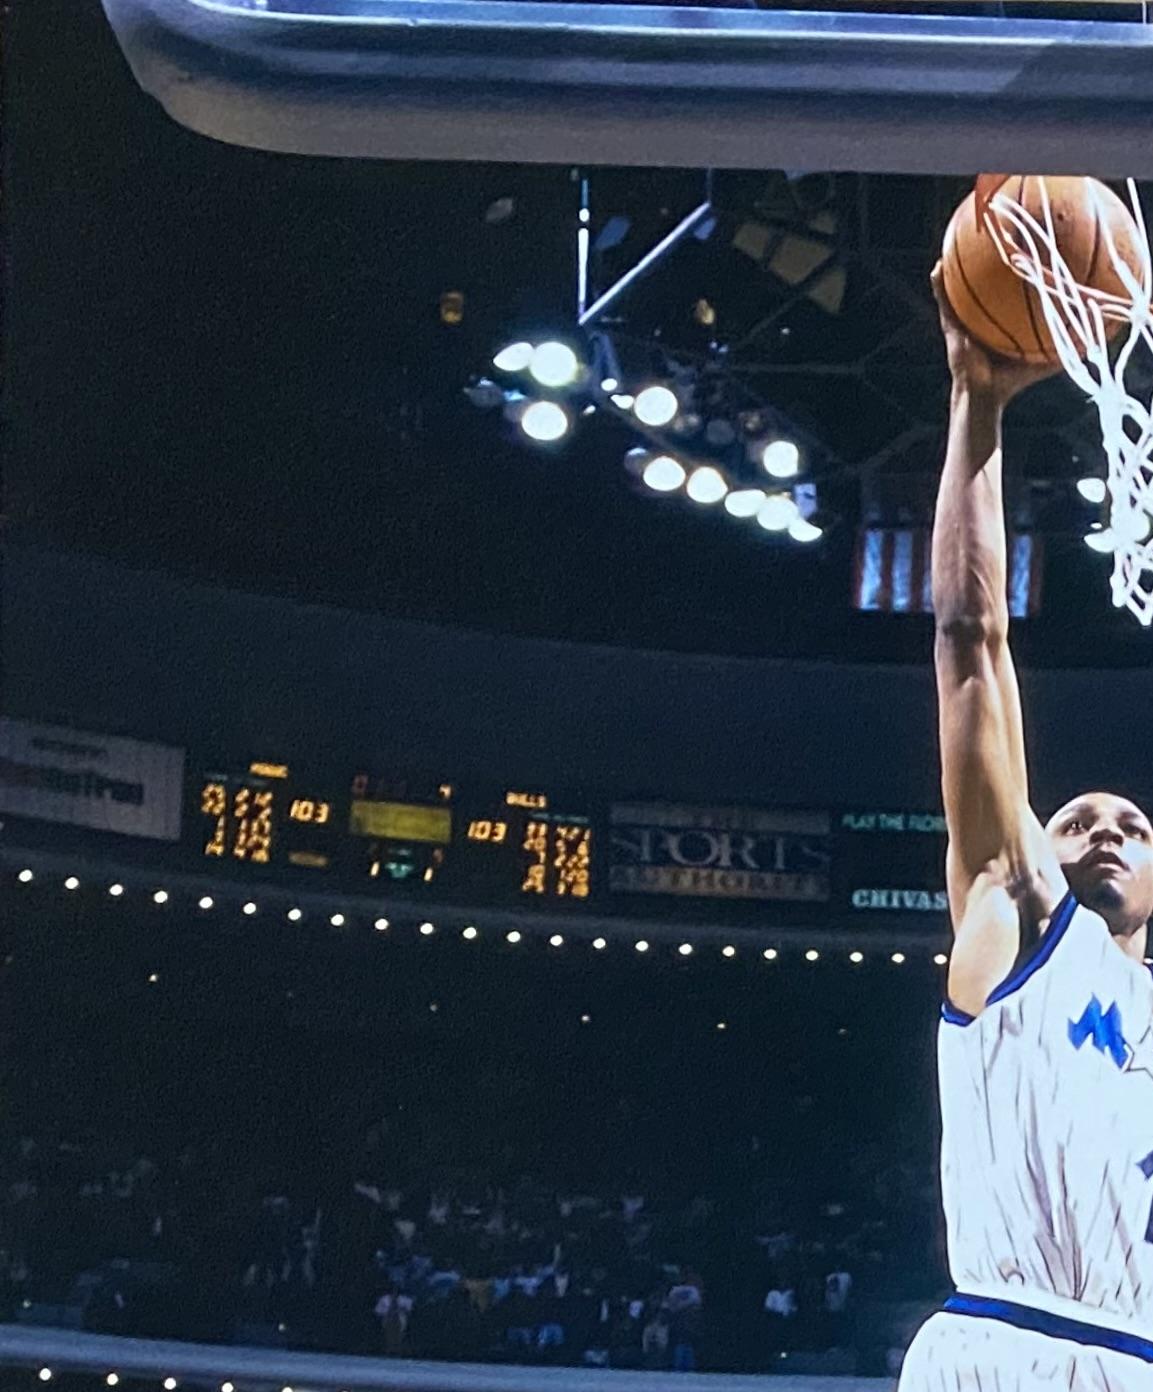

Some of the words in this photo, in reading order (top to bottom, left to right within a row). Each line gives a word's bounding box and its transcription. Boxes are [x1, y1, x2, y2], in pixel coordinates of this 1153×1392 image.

[290, 799, 329, 823] 103
[467, 821, 507, 842] 103
[852, 889, 948, 911] CHIVAS
